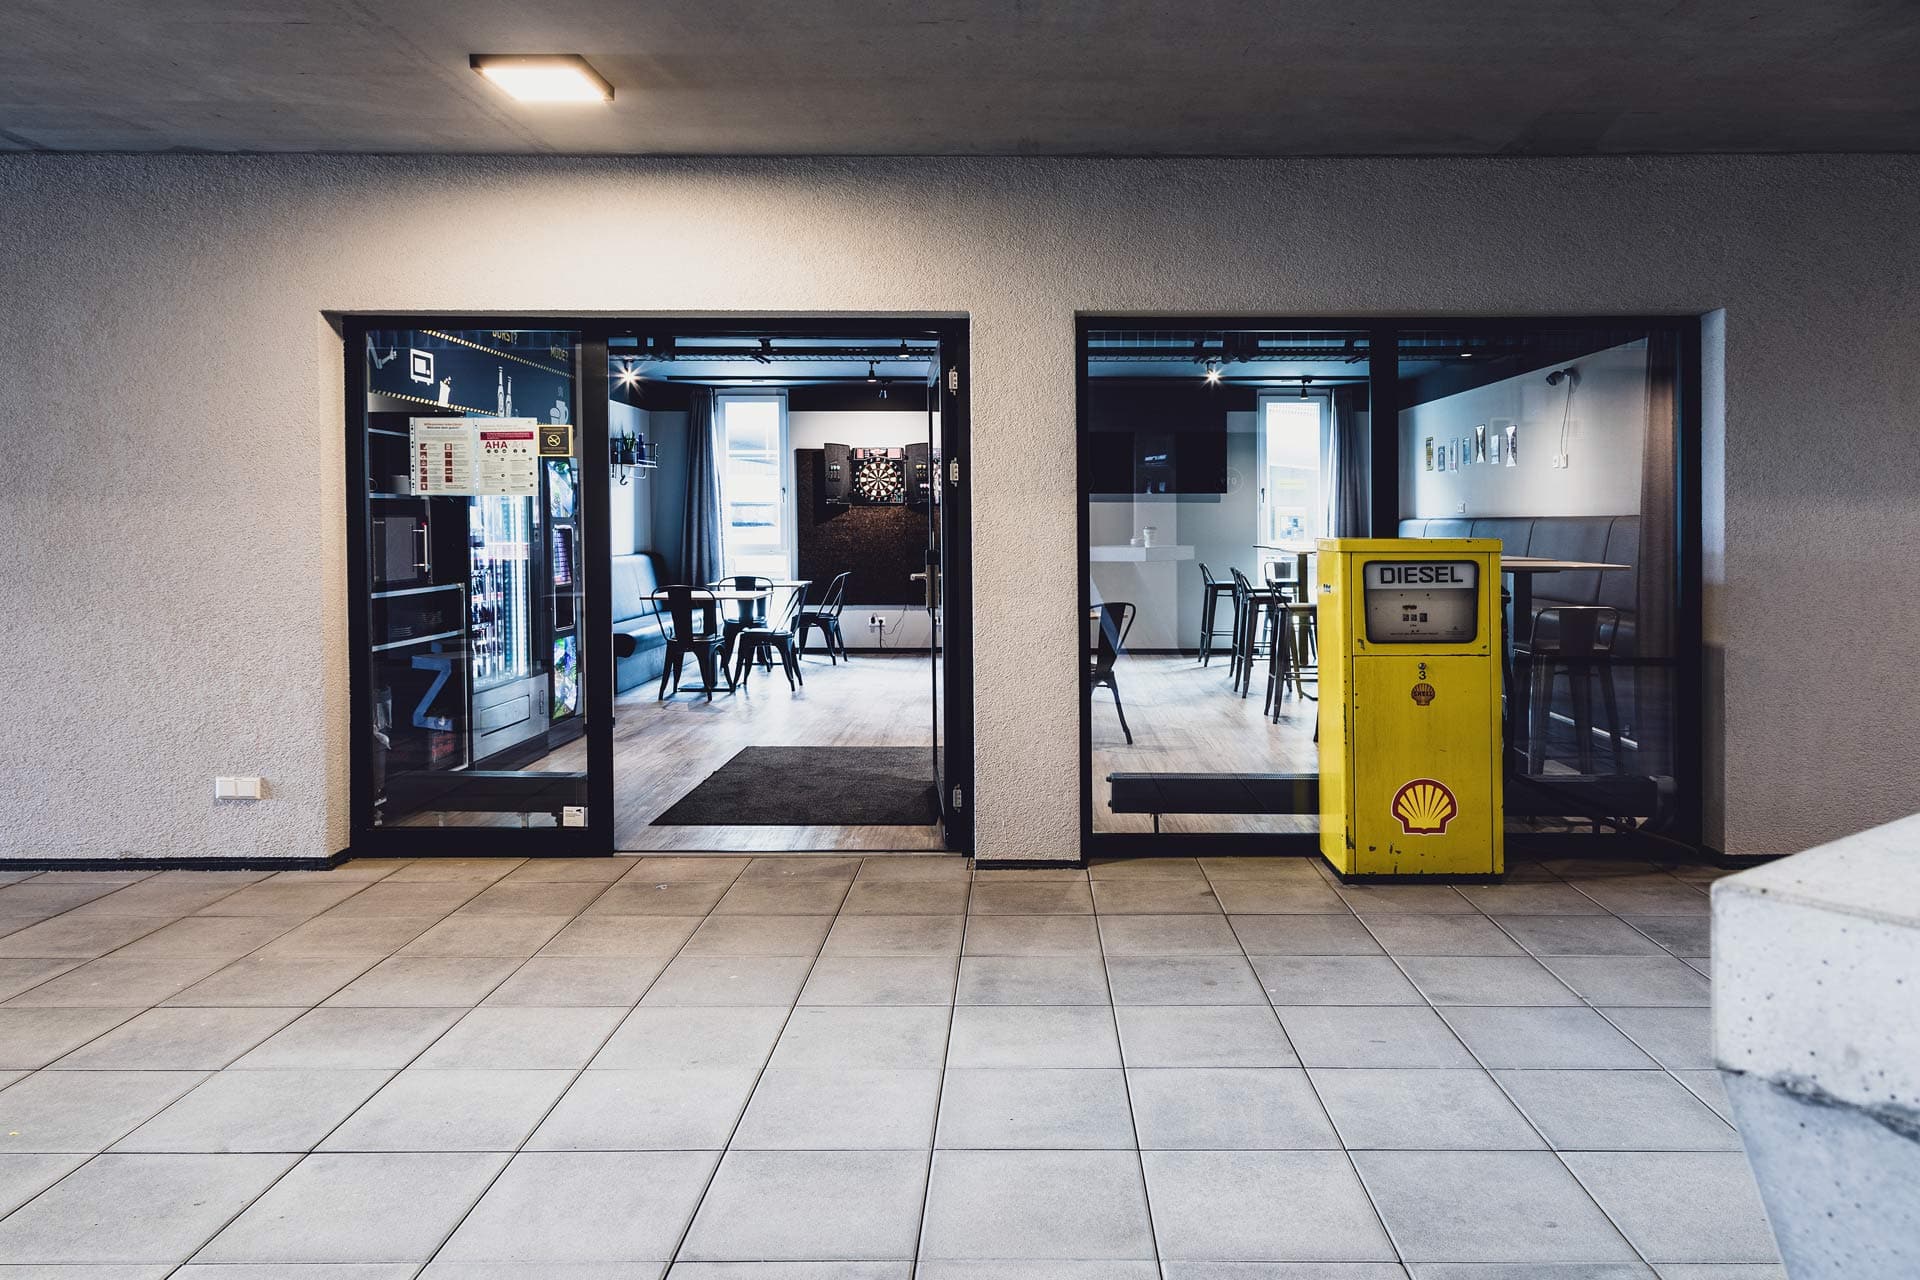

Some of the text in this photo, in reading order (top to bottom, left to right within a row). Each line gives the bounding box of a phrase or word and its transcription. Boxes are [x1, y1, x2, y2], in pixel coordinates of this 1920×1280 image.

[485, 441, 508, 449] AHA
[1380, 566, 1463, 585] DIESEL
[1418, 671, 1427, 680] 3
